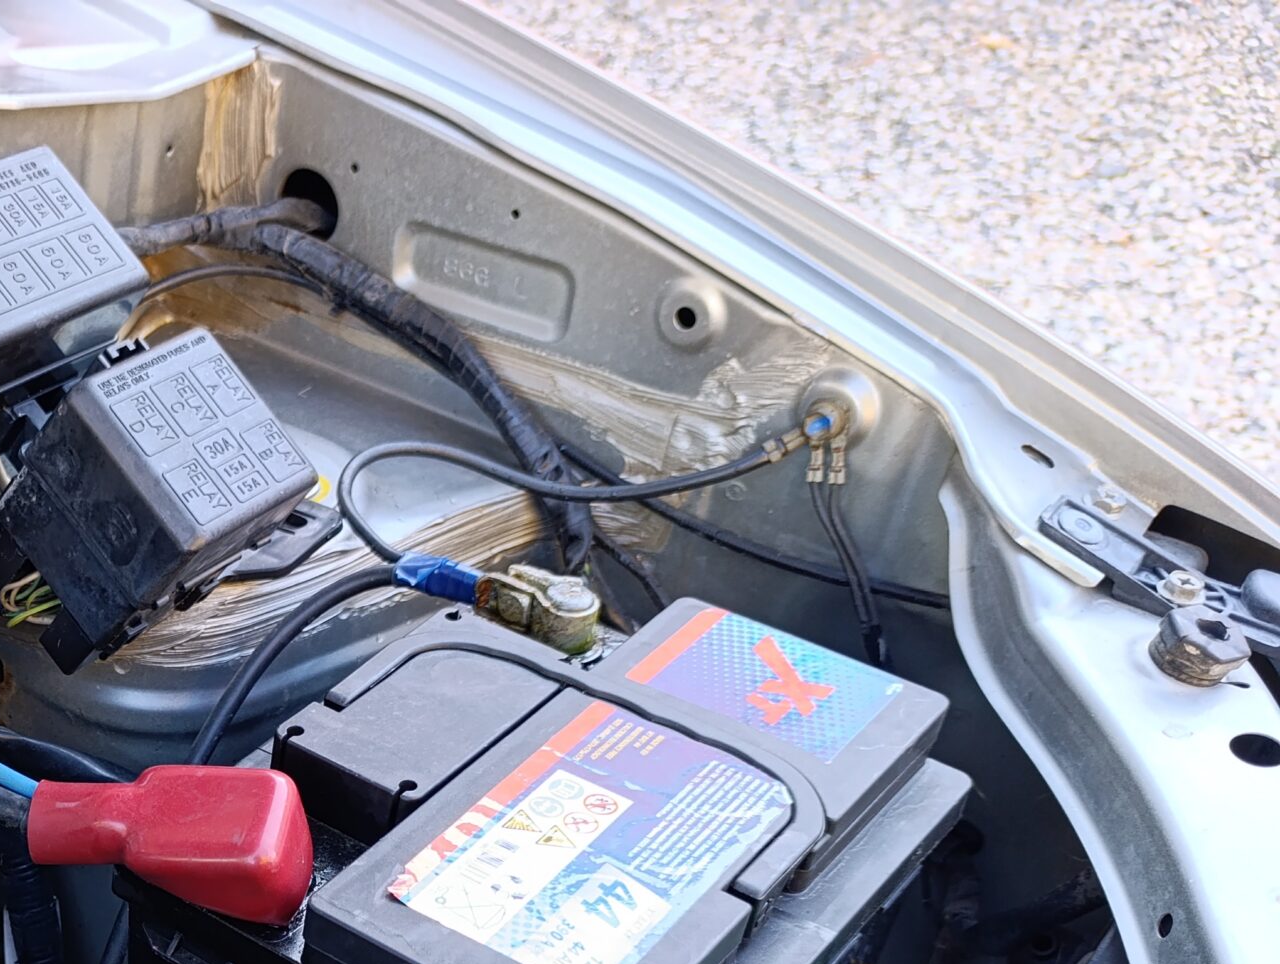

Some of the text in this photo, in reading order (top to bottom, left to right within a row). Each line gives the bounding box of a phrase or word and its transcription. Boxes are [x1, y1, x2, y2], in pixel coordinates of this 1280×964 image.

[20, 161, 37, 173] AND
[97, 335, 207, 391] USE THE DESIGNATED FUSES AND
[103, 383, 132, 399] RELAYS
[206, 383, 219, 396] A
[208, 357, 251, 403] RELAY
[170, 402, 185, 414] C
[171, 378, 215, 423] RELAY
[129, 422, 146, 433] D
[130, 396, 175, 442] RELAY
[204, 436, 235, 460] 30A
[258, 448, 274, 461] B
[259, 424, 303, 468] RELAY
[223, 456, 247, 479] 15A
[181, 488, 200, 504] E
[182, 463, 228, 510] RELAY
[236, 474, 261, 497] 15A
[580, 879, 638, 929] 44
